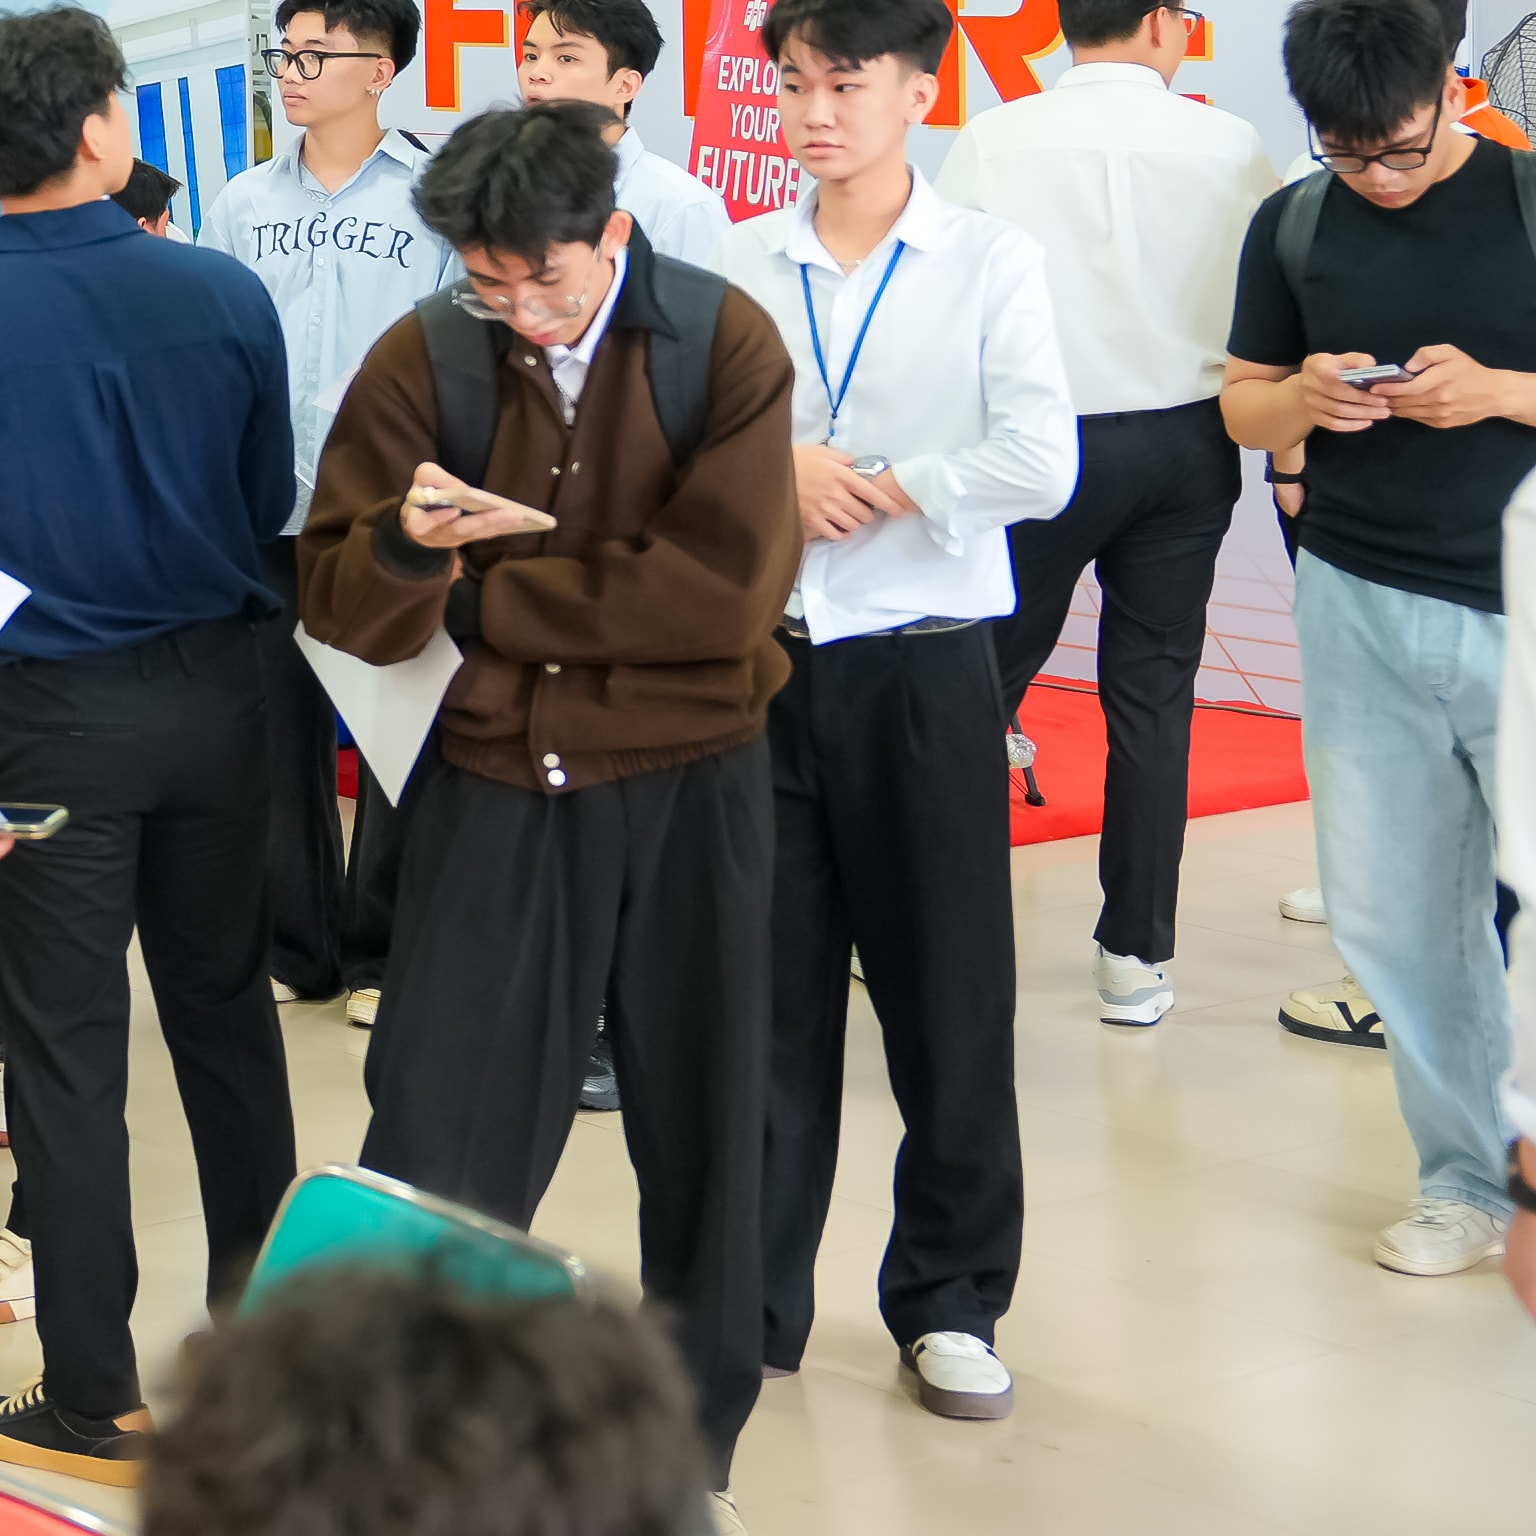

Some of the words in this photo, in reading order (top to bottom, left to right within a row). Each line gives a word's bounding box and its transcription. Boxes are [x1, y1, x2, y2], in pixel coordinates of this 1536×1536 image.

[717, 55, 779, 96] EXPLO
[730, 102, 781, 144] YOUR
[696, 145, 801, 208] FUTURE
[252, 212, 415, 268] TRIGGER
